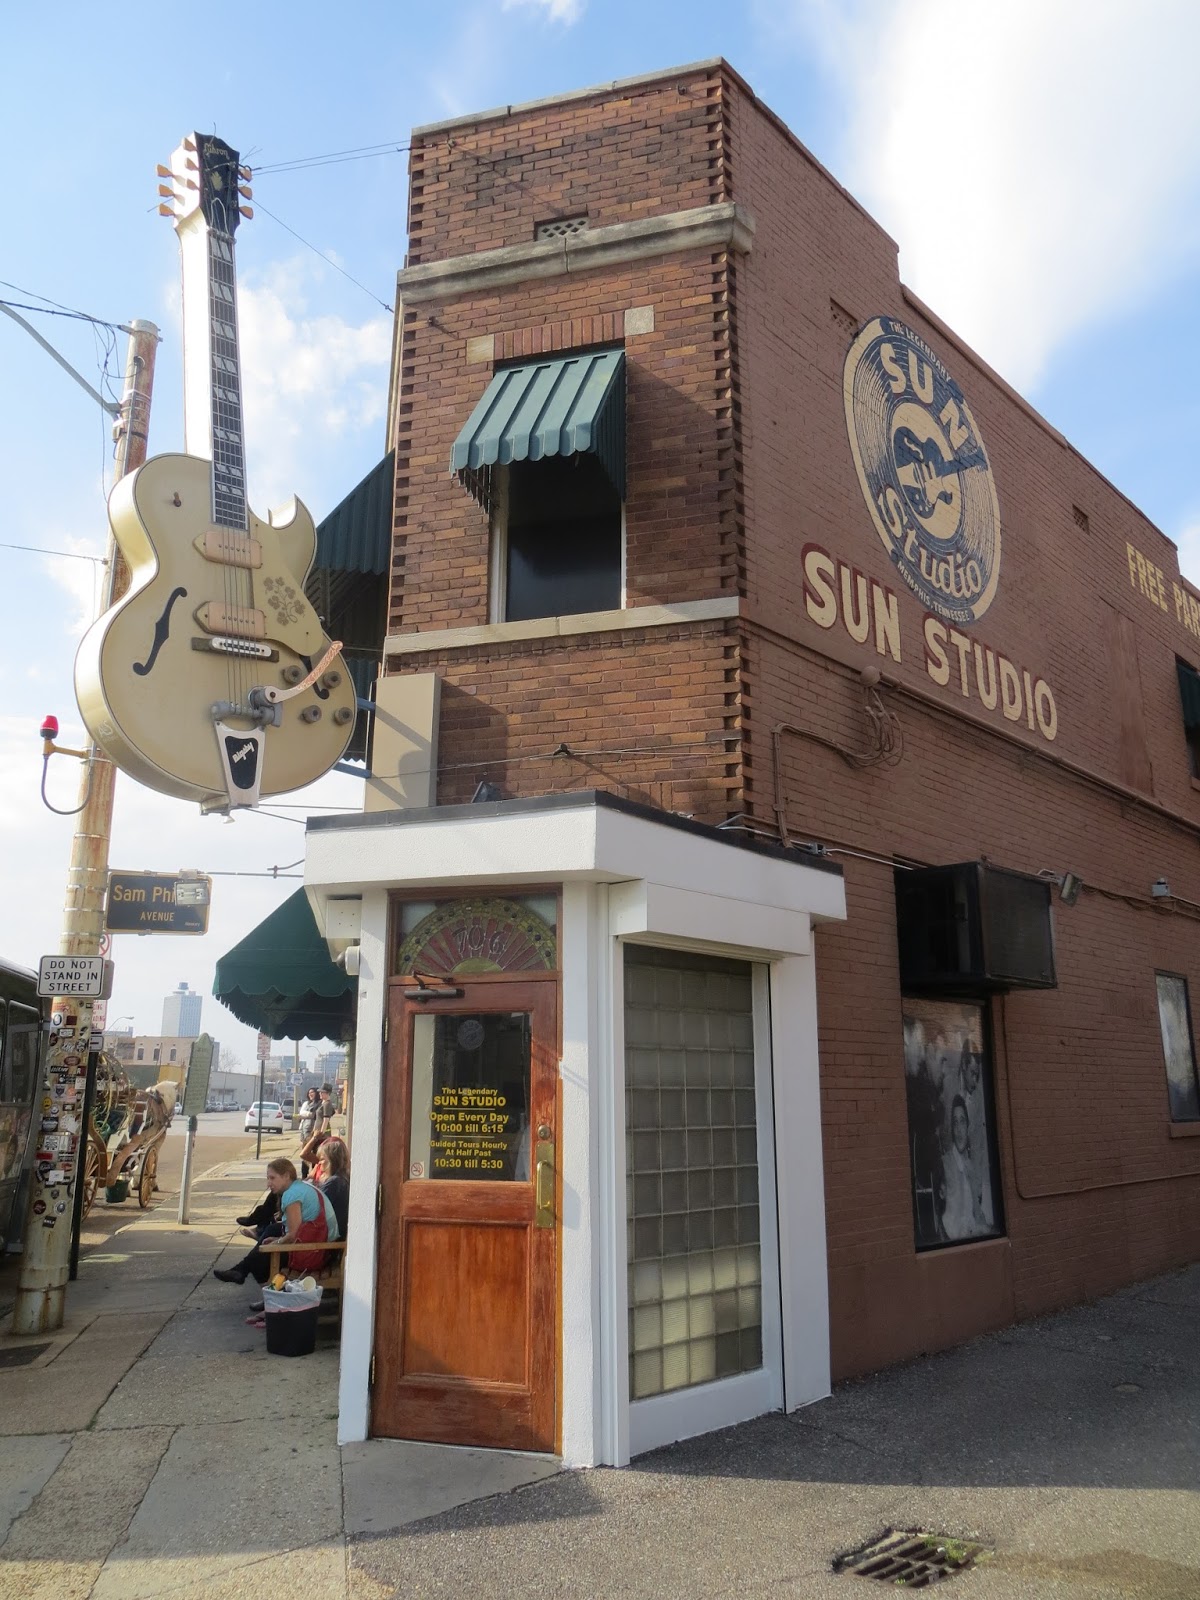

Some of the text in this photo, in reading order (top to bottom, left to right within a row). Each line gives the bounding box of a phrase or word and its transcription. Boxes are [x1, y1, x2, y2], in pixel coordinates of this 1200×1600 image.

[889, 321, 952, 382] THE LEGENDARY
[880, 342, 969, 451] SUN
[877, 486, 982, 599] Studio
[1126, 541, 1200, 638] FREE PAR
[933, 600, 970, 622] TENNESSEE
[802, 546, 1058, 741] SUN STUDIO
[113, 884, 146, 902] Sam
[140, 911, 175, 922] AVENUE
[451, 925, 507, 955] 706
[50, 960, 94, 969] DO NOT
[44, 971, 98, 980] STAND IN
[48, 982, 91, 992] STREET
[442, 1087, 498, 1096] The Legendary
[434, 1096, 507, 1107] SUN STUDIO
[429, 1112, 509, 1124] Open Every Day
[435, 1123, 504, 1133] 10:00 till 6:15
[430, 1140, 456, 1148] Guided
[482, 1141, 508, 1150] Hourly
[445, 1148, 454, 1156] At
[434, 1158, 503, 1169] 10:30 till 5:30
